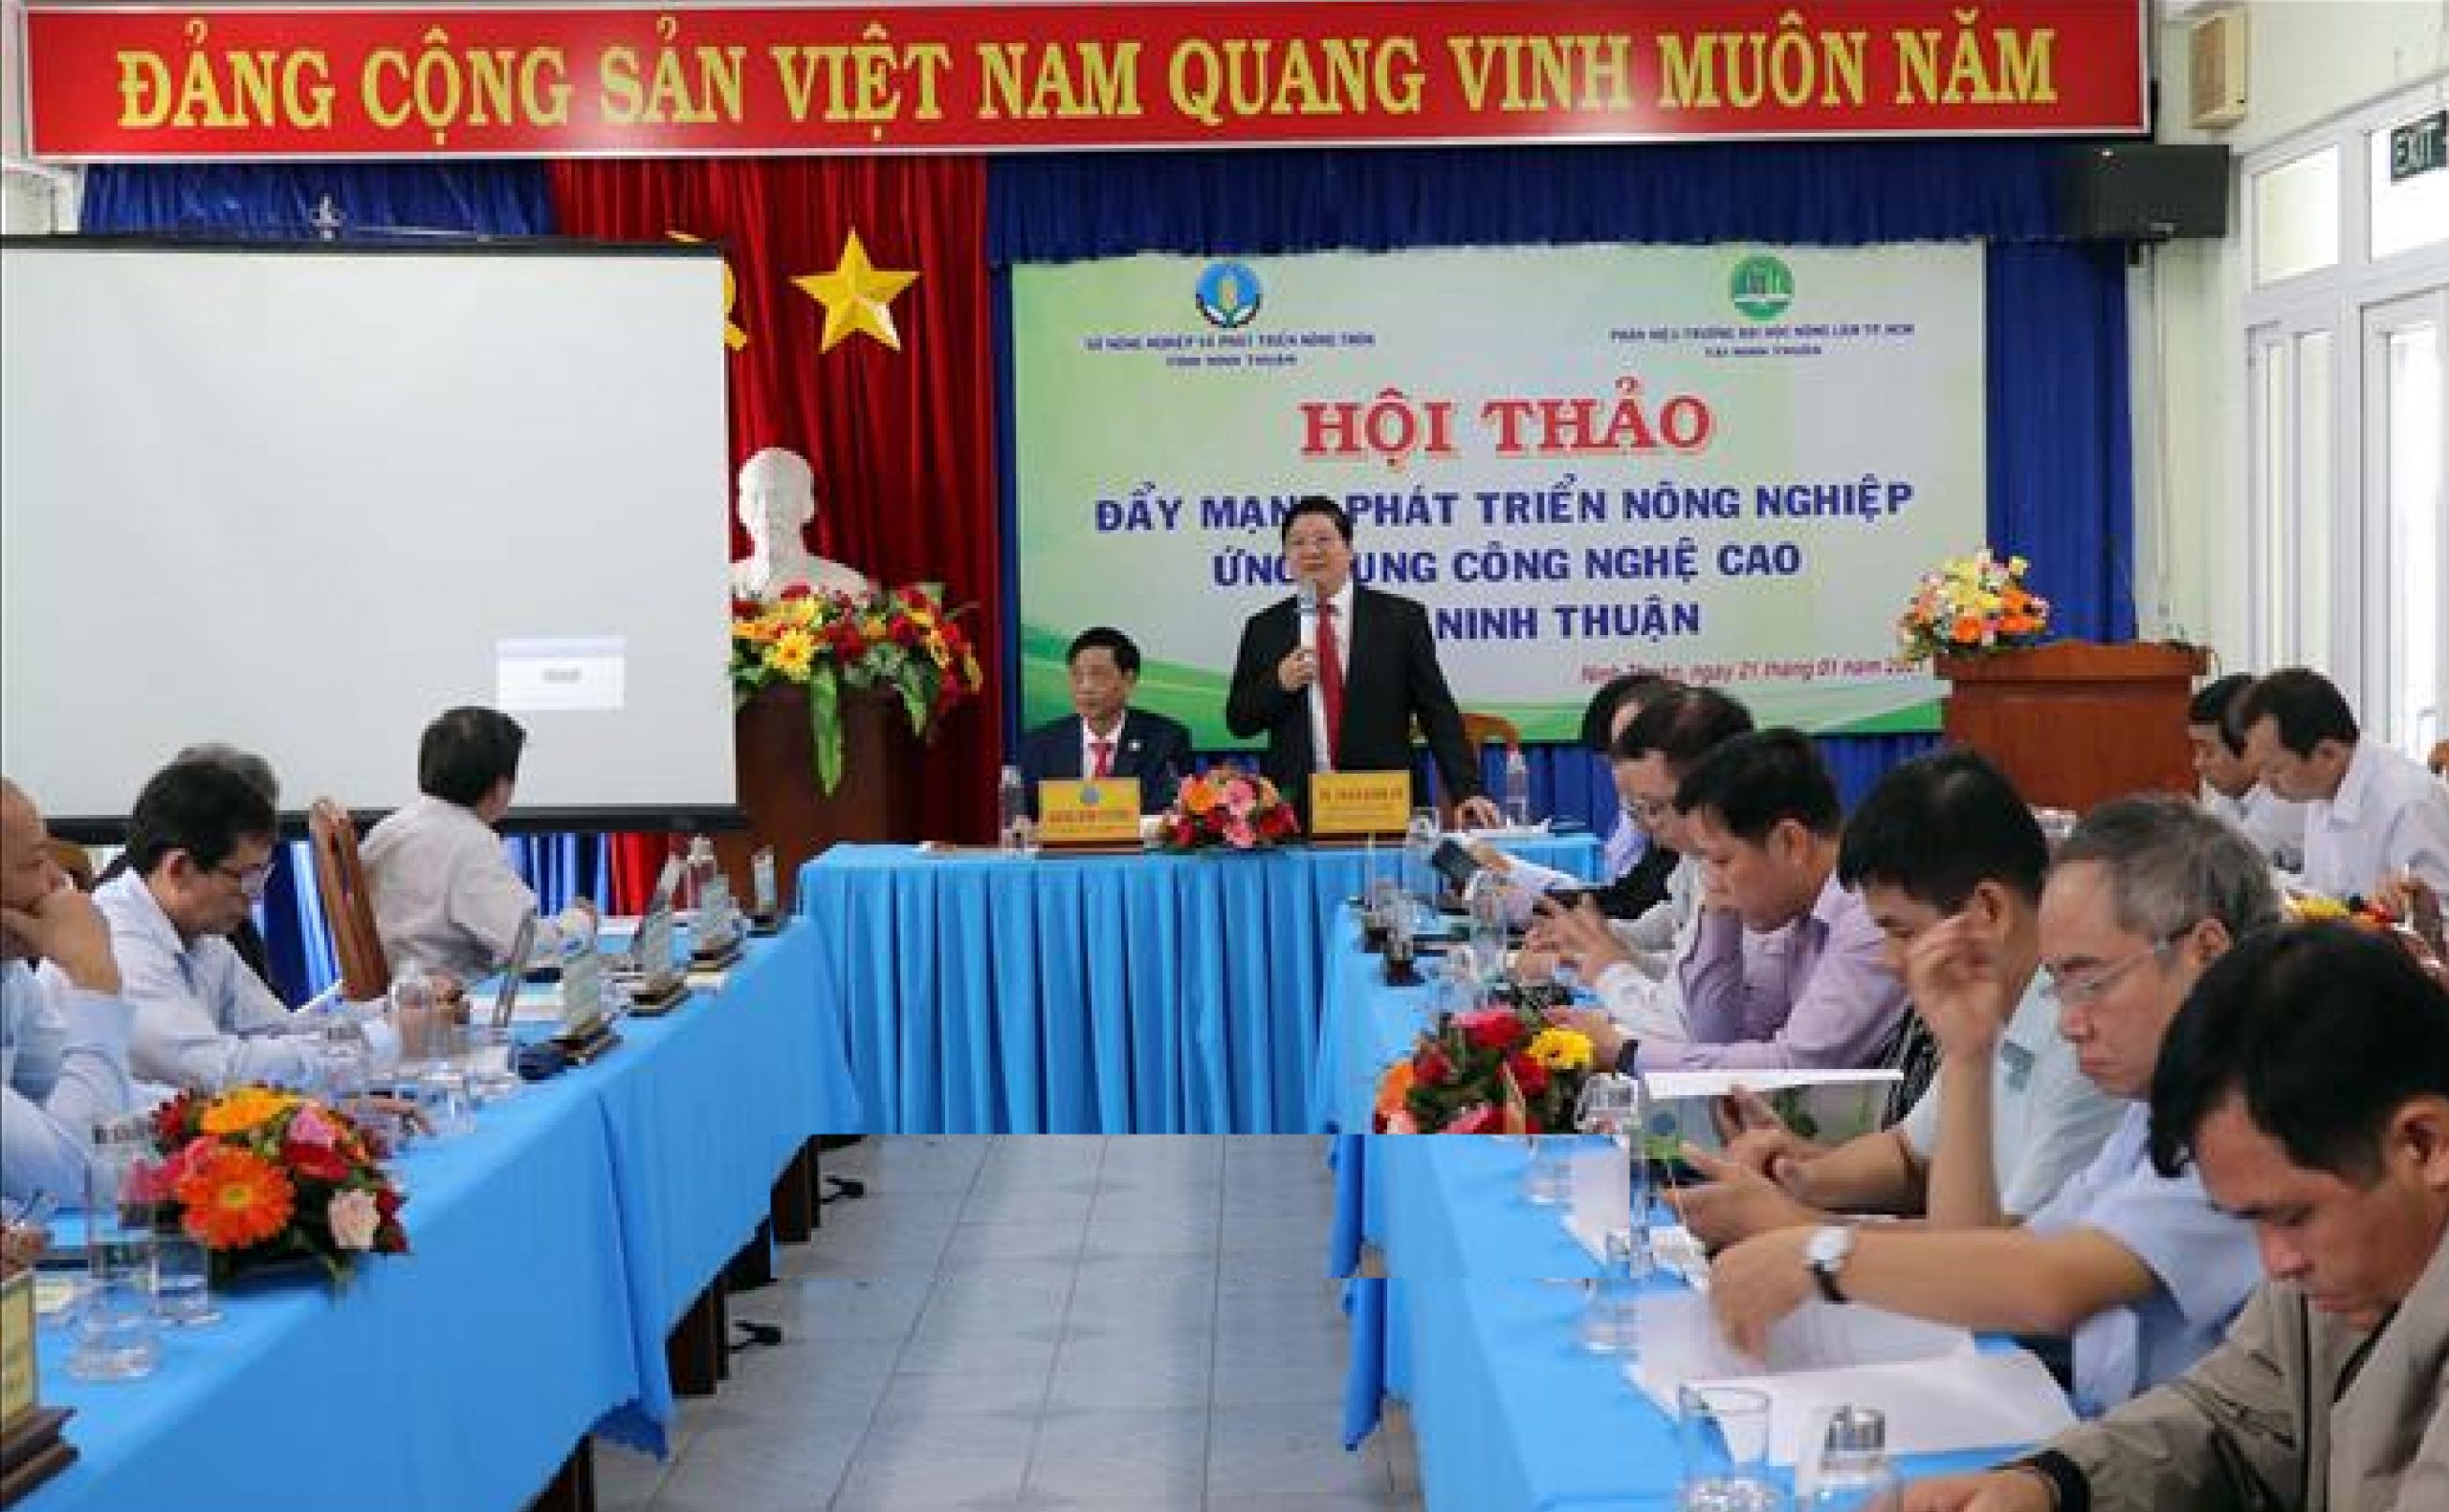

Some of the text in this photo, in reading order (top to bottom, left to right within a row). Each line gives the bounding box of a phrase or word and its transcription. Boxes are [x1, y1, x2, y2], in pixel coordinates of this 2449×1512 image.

[117, 6, 2058, 144] ĐẢNG CỘNG SẢN VIỆT NAM QUANG VINH MUÔN NĂM
[2394, 121, 2440, 174] EXIT
[1299, 376, 1712, 466] HỘI THẢO
[1095, 473, 1912, 534] ĐẨY MẠN PHÁT TRIỂN NÔNG NGHIỆP
[1452, 540, 1570, 582] CÔNG
[1585, 537, 1699, 583] NGHỆ
[1716, 543, 1802, 576] CAO
[1435, 594, 1700, 642] NINH THUẬN
